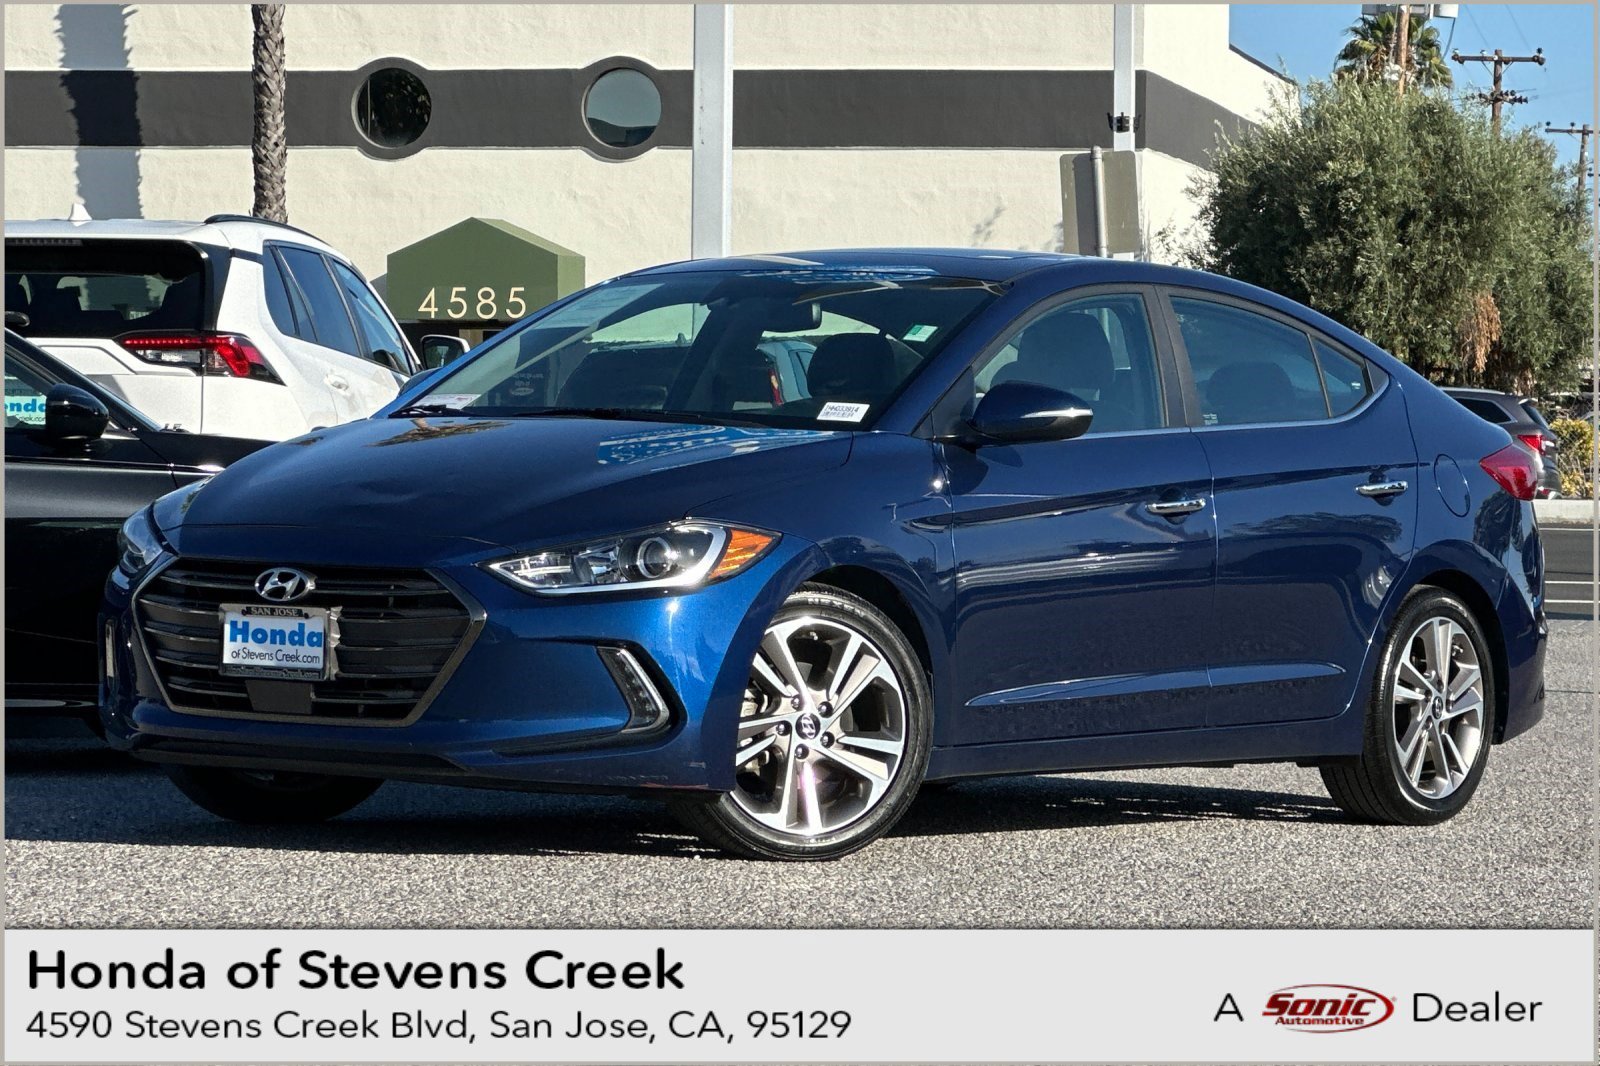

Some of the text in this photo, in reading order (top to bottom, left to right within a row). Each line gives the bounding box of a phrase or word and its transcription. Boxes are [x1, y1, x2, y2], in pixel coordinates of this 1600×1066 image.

[418, 287, 526, 319] 4585
[250, 606, 299, 617] SAN JOSE
[229, 620, 323, 648] Honda
